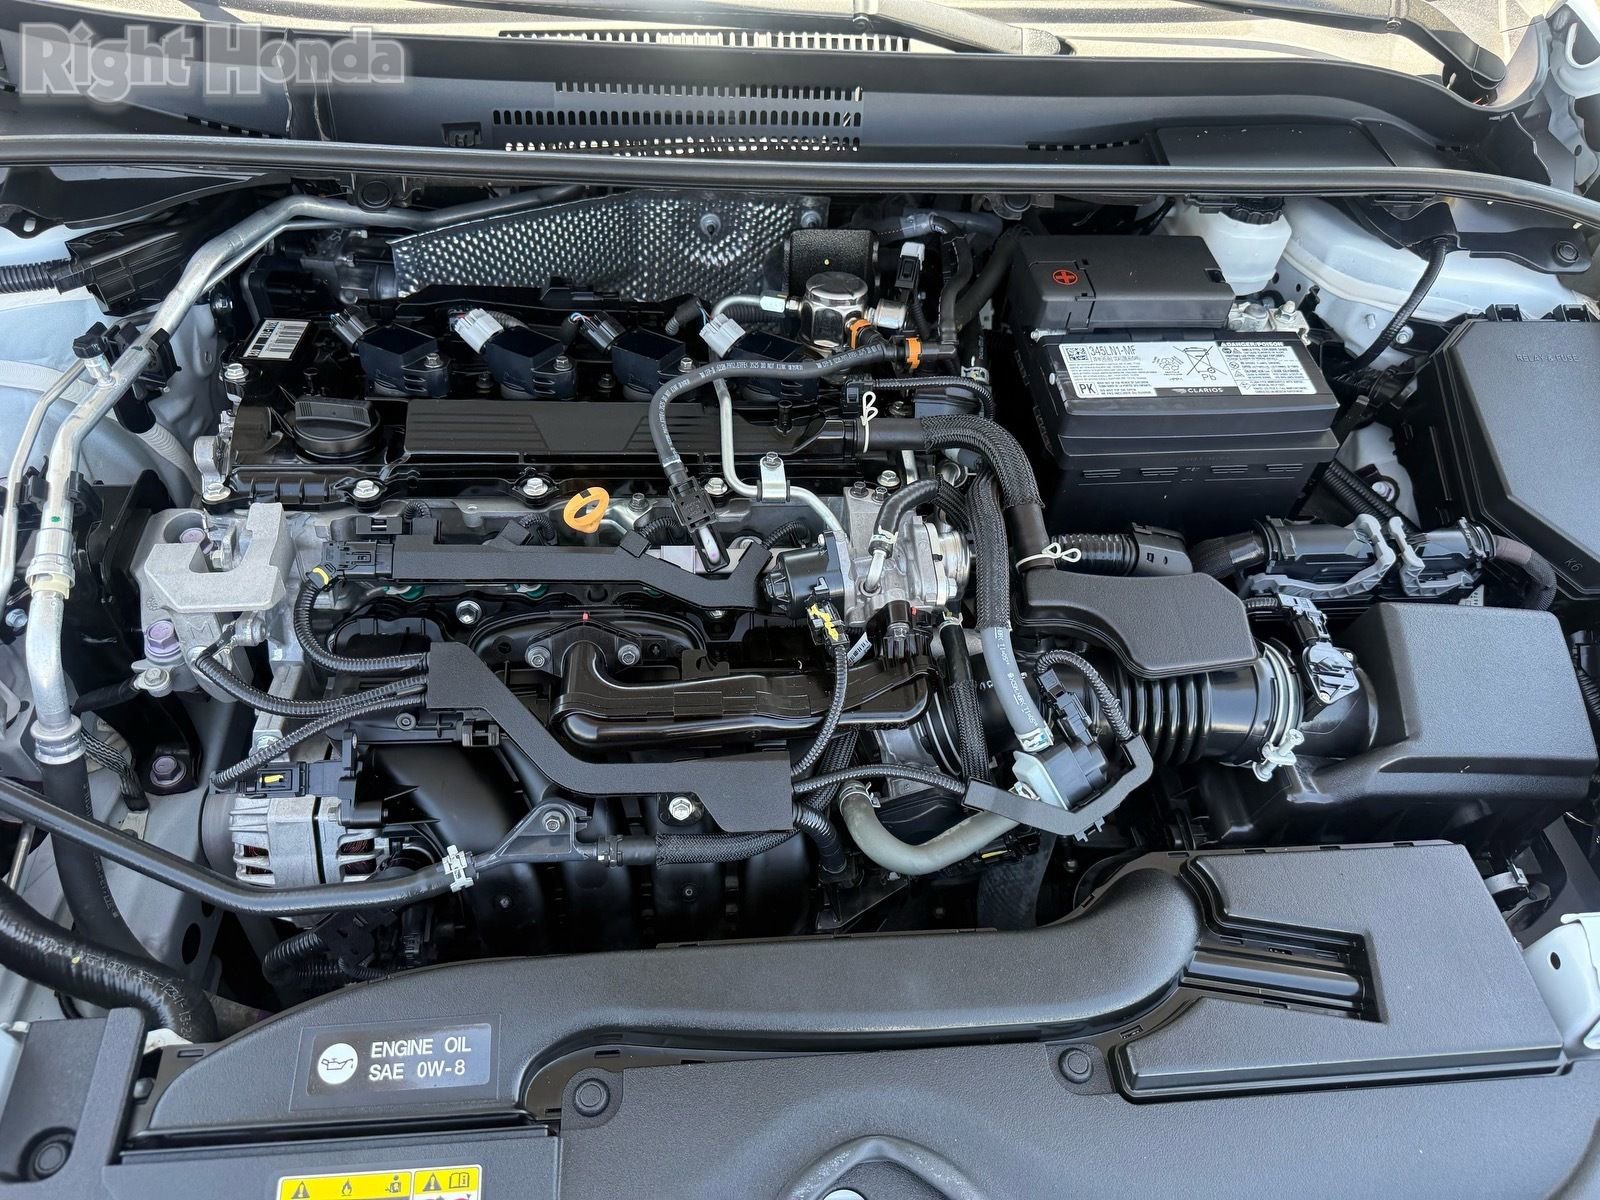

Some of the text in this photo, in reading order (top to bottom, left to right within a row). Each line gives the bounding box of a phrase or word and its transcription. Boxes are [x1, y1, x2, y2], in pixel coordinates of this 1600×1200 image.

[1088, 345, 1137, 357] 345LN1-MF
[1202, 373, 1217, 381] Pb
[1079, 383, 1097, 395] PK
[371, 1036, 472, 1059] ENGINE OIL
[368, 1059, 466, 1081] SAE 0W-8
